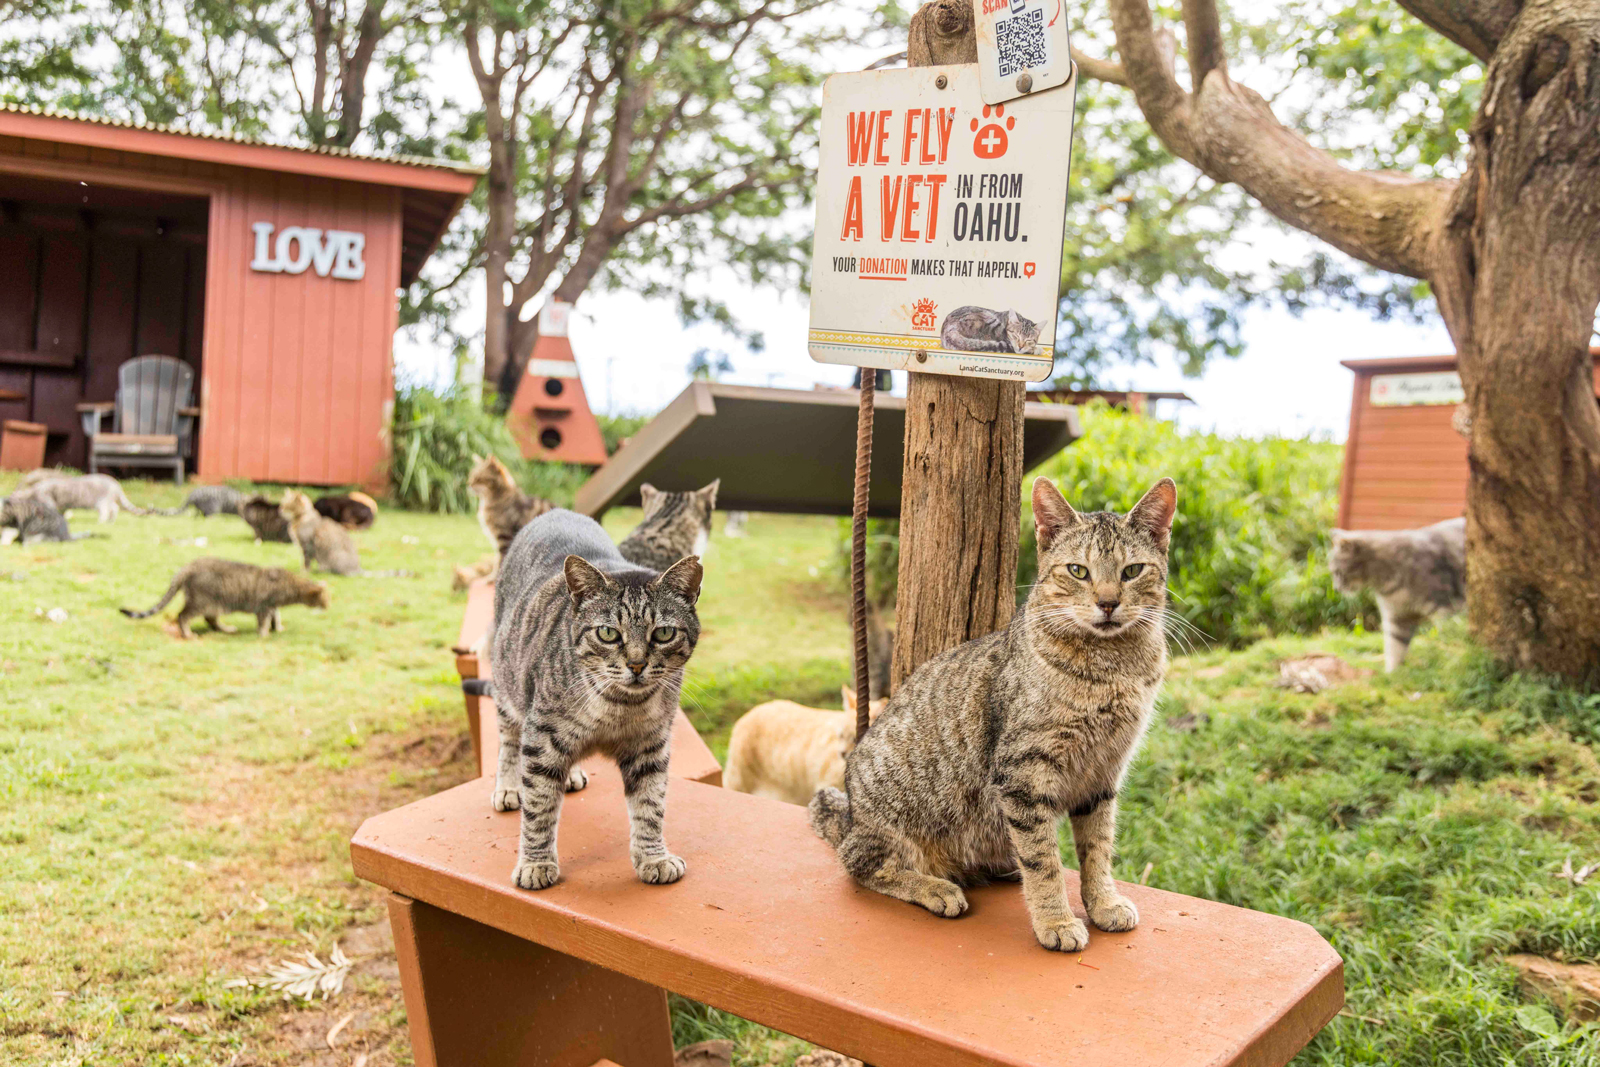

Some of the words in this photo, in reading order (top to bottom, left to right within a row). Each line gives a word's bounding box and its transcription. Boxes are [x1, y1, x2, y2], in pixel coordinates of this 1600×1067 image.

[846, 110, 893, 167] WE
[900, 106, 957, 166] FLY
[956, 174, 974, 199] IN
[979, 173, 1023, 199] FROM
[840, 175, 864, 242] A
[880, 174, 948, 243] VET
[953, 201, 1028, 242] OAHU.
[250, 221, 366, 281] LOVE
[832, 256, 857, 273] YOUR
[859, 257, 908, 275] DONATION
[911, 258, 945, 277] MAKES
[949, 259, 974, 278] THAT
[977, 260, 1022, 279] HAPPEN.
[911, 311, 937, 326] CAT
[959, 364, 1025, 377] LanaiCatSanctuary.org
